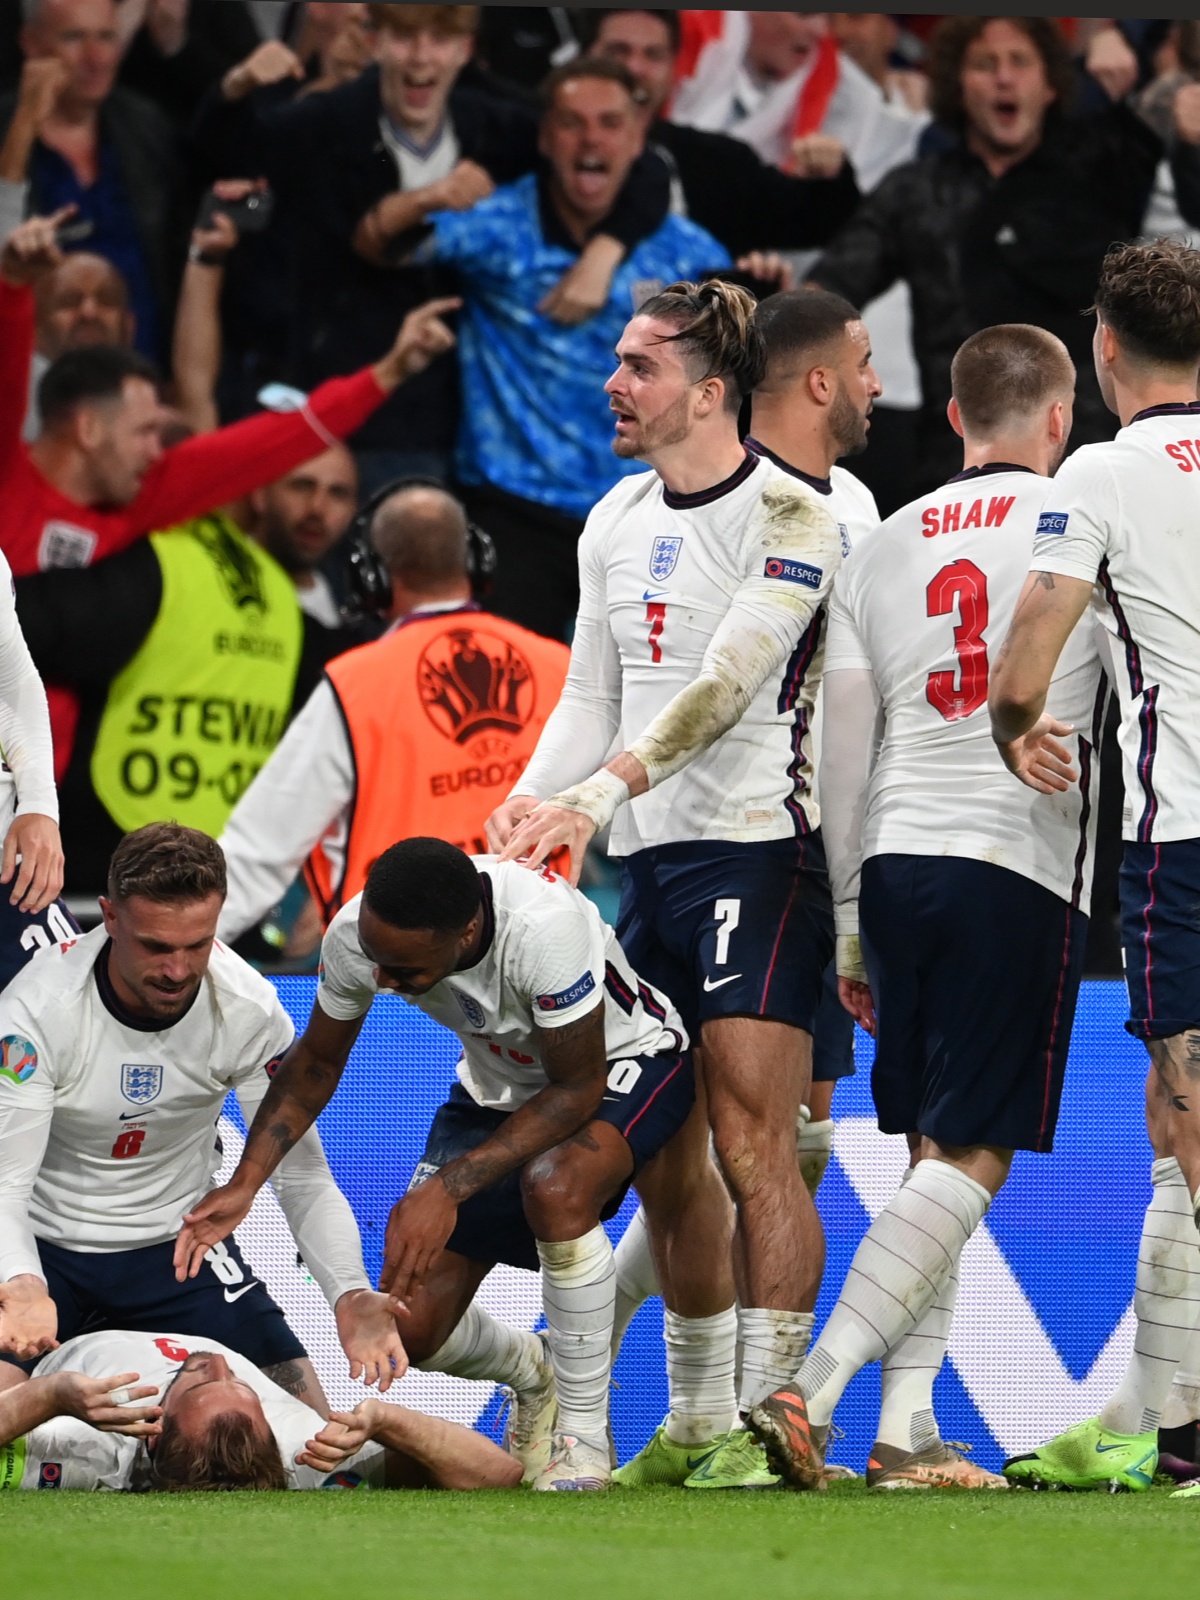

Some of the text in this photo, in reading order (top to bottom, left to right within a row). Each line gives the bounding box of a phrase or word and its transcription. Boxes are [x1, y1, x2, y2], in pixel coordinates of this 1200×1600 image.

[921, 496, 1016, 538] SHAW
[784, 565, 822, 585] RESPECT
[645, 602, 667, 663] 7
[926, 558, 989, 722] 3
[430, 757, 531, 797] EURO2
[20, 903, 80, 958] 20
[714, 899, 741, 965] 7
[556, 975, 593, 1006] RESPECT
[111, 1129, 146, 1160] 8
[203, 1240, 244, 1286] 8
